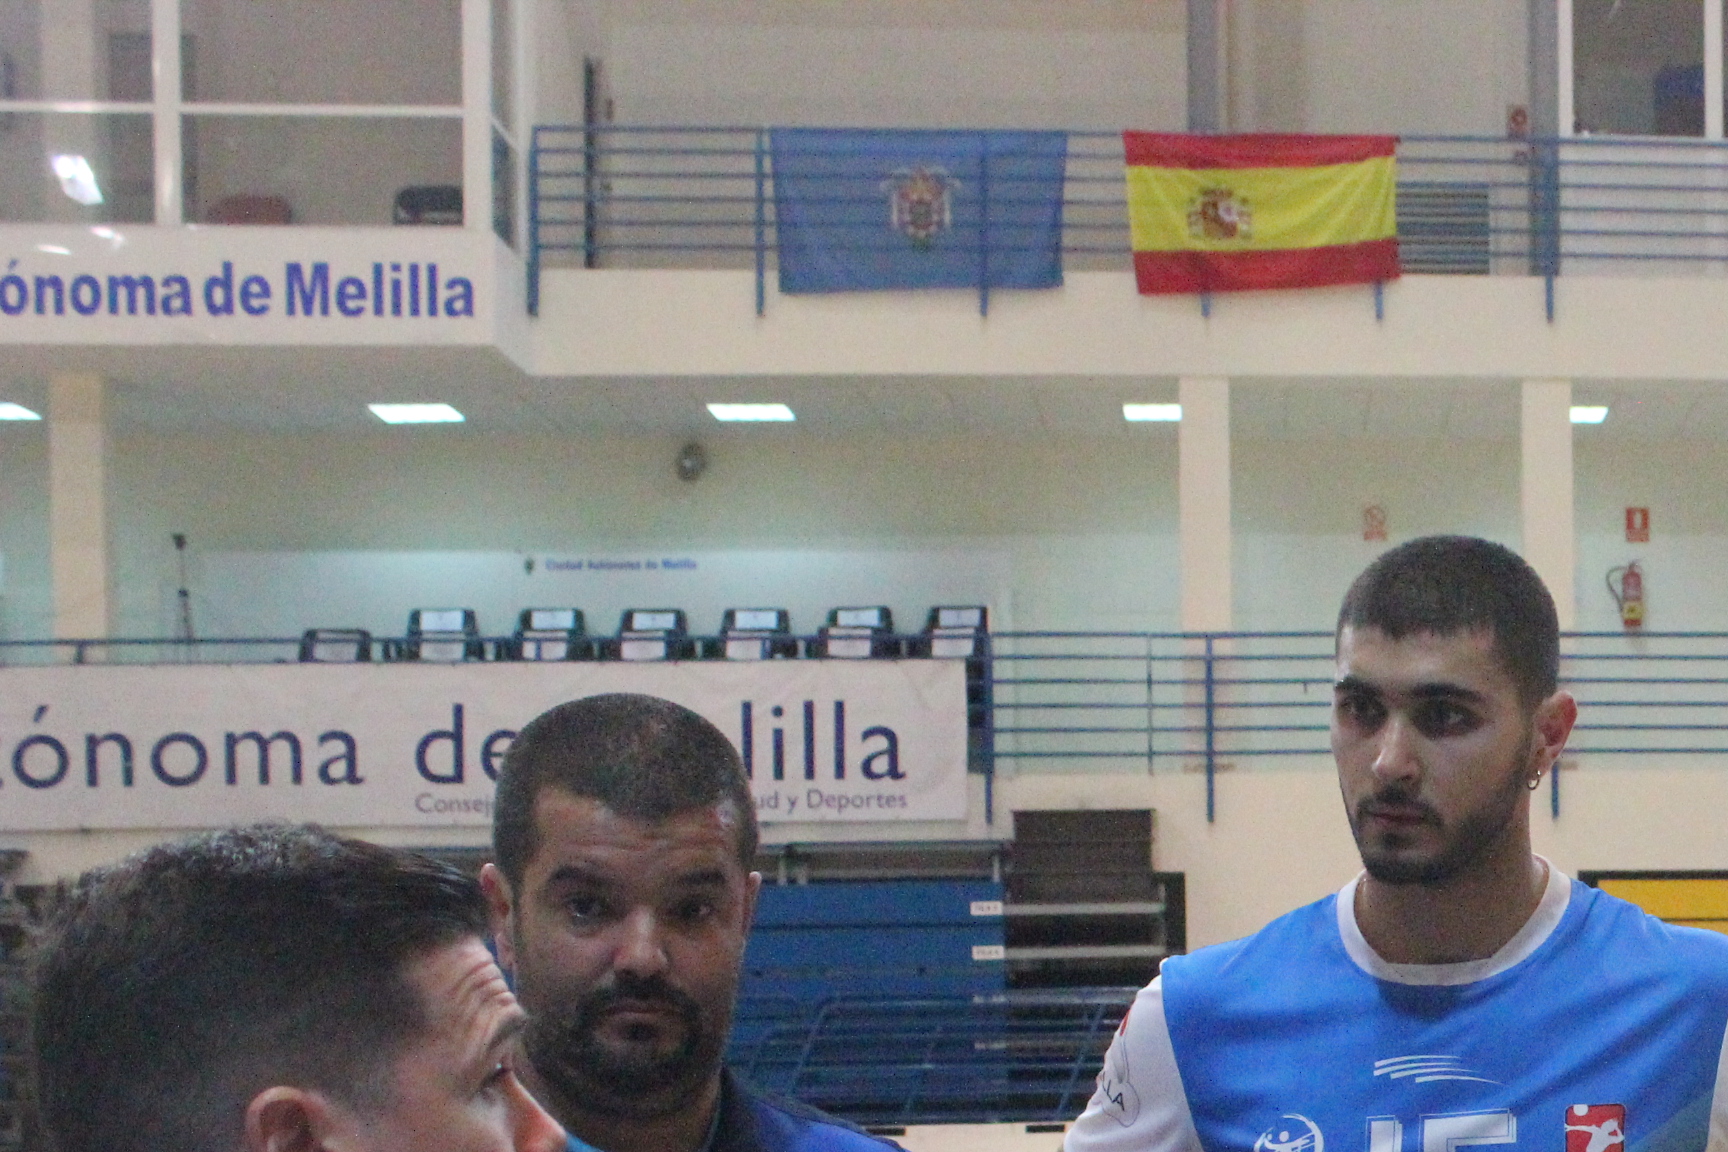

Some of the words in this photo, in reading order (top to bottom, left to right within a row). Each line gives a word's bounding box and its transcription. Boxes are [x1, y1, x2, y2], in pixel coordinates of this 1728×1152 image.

[203, 261, 272, 317] de
[285, 261, 475, 318] Melilla
[0, 704, 366, 790] ónoma
[740, 699, 906, 783] lilla
[806, 788, 909, 814] Deportes
